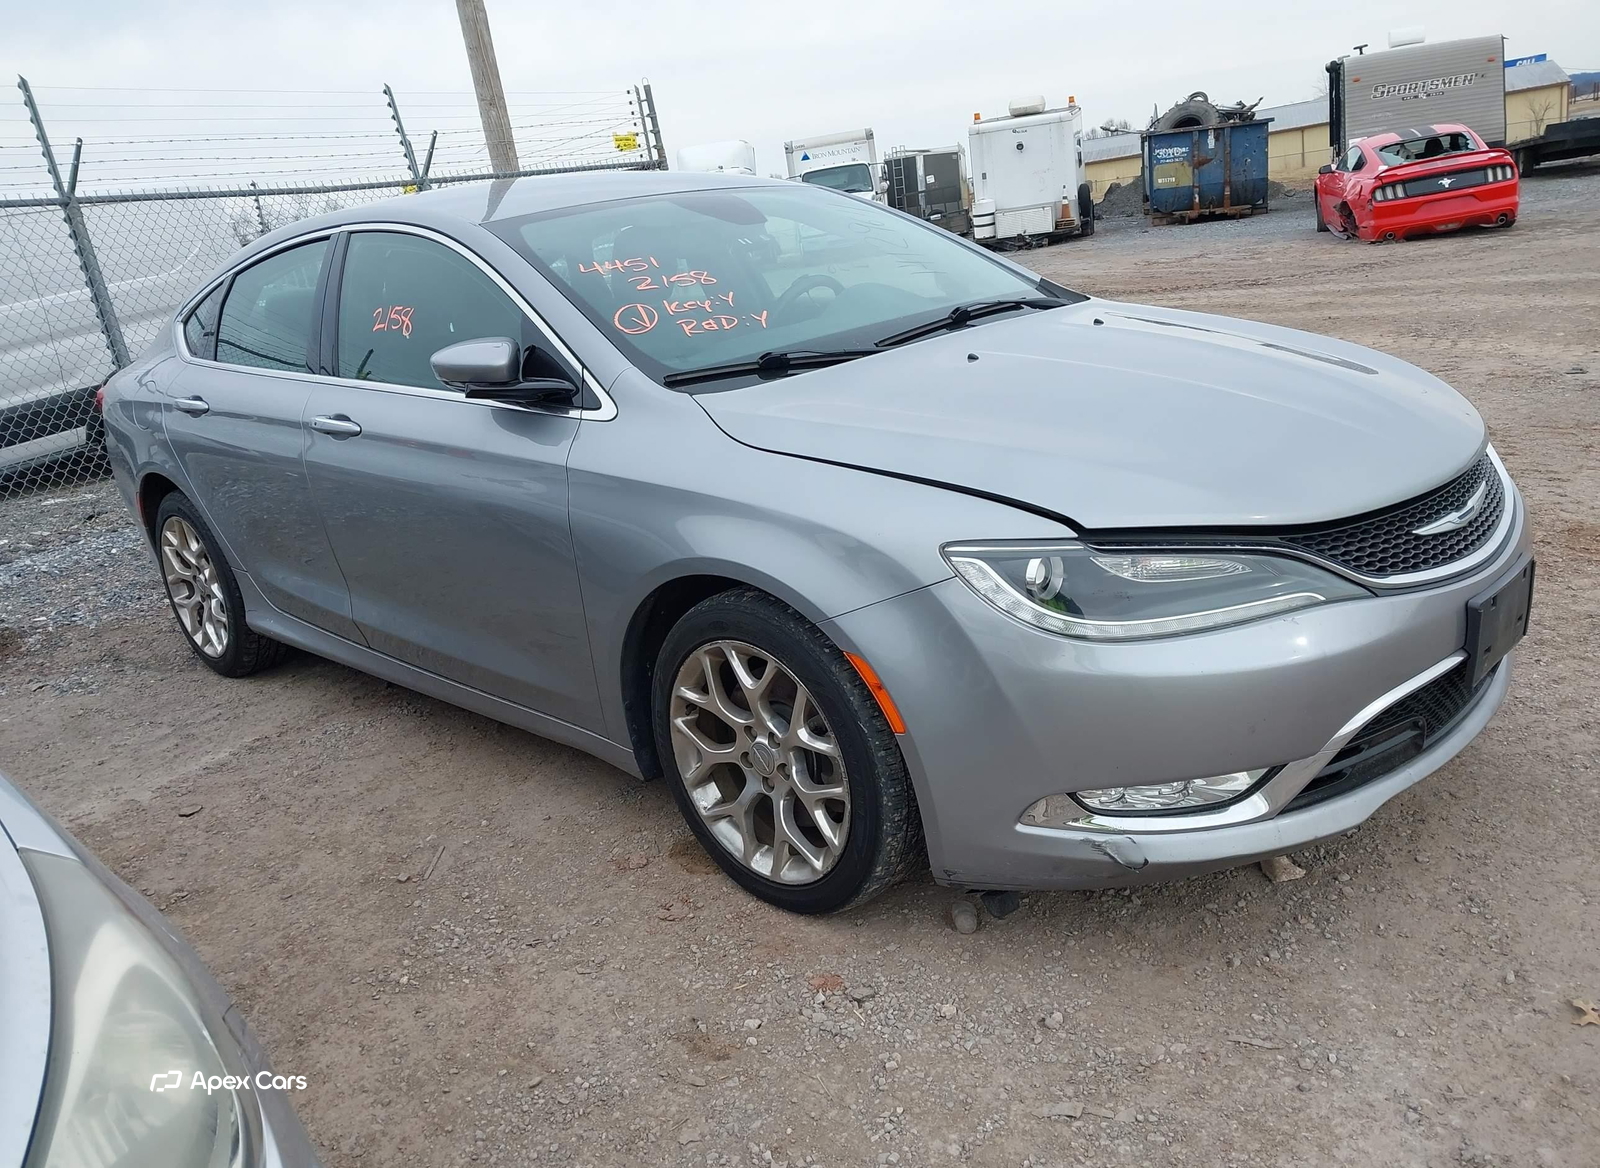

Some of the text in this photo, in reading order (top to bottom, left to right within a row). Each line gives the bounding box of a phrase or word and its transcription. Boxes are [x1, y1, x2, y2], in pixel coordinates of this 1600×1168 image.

[828, 147, 861, 158] MOUNTAIN
[578, 256, 660, 275] 4451
[628, 270, 717, 290] 2158
[372, 305, 415, 337] 2158
